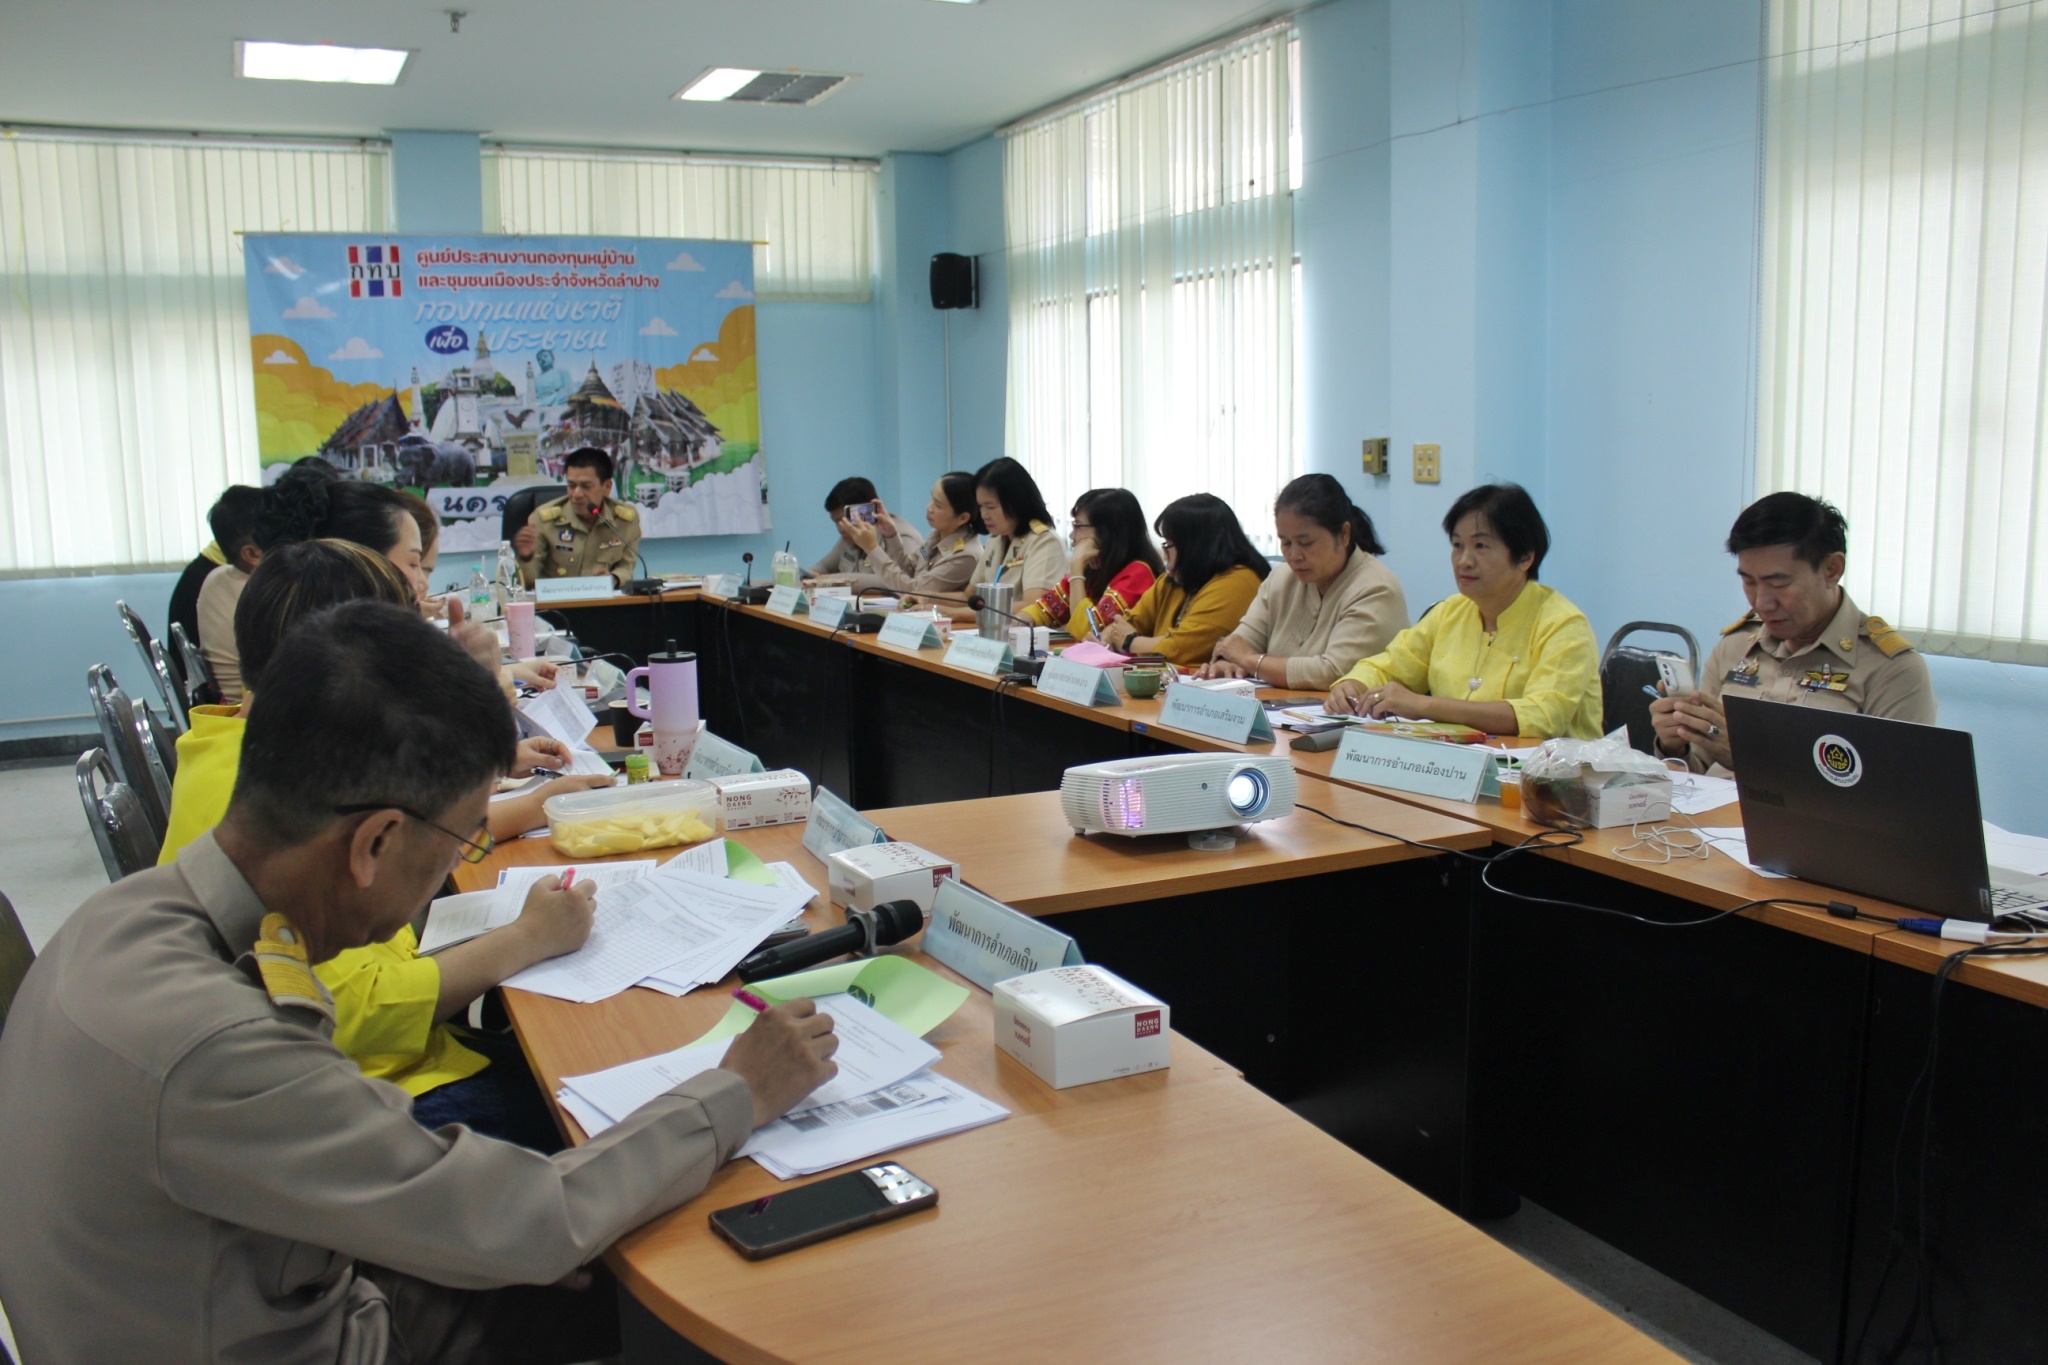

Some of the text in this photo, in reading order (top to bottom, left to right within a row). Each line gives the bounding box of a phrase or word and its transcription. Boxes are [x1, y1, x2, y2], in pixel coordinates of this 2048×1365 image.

[417, 249, 635, 268] ศูนย์ประสานงานกองทุนหมู่บ้าน
[350, 262, 400, 279] กทบ
[418, 273, 660, 291] และชุมชนเมืองประจำจังหวัดลำปาง
[415, 294, 622, 326] กองทุนแห่งชาติ
[429, 327, 464, 348] เพื่อ
[487, 327, 607, 351] ประชาชน
[1171, 698, 1246, 725] พัฒนาการอำเภอเสริมงาม
[1345, 749, 1467, 780] พัฒนาการอำเภอเมืองปาน
[726, 794, 752, 802] NONG
[948, 910, 1039, 973] พัฒนาการอำเภอเถิน
[1057, 968, 1095, 989] DAENG
[1069, 967, 1110, 987] NONG
[1136, 1018, 1159, 1028] NONG
[1136, 1024, 1159, 1033] DAENG
